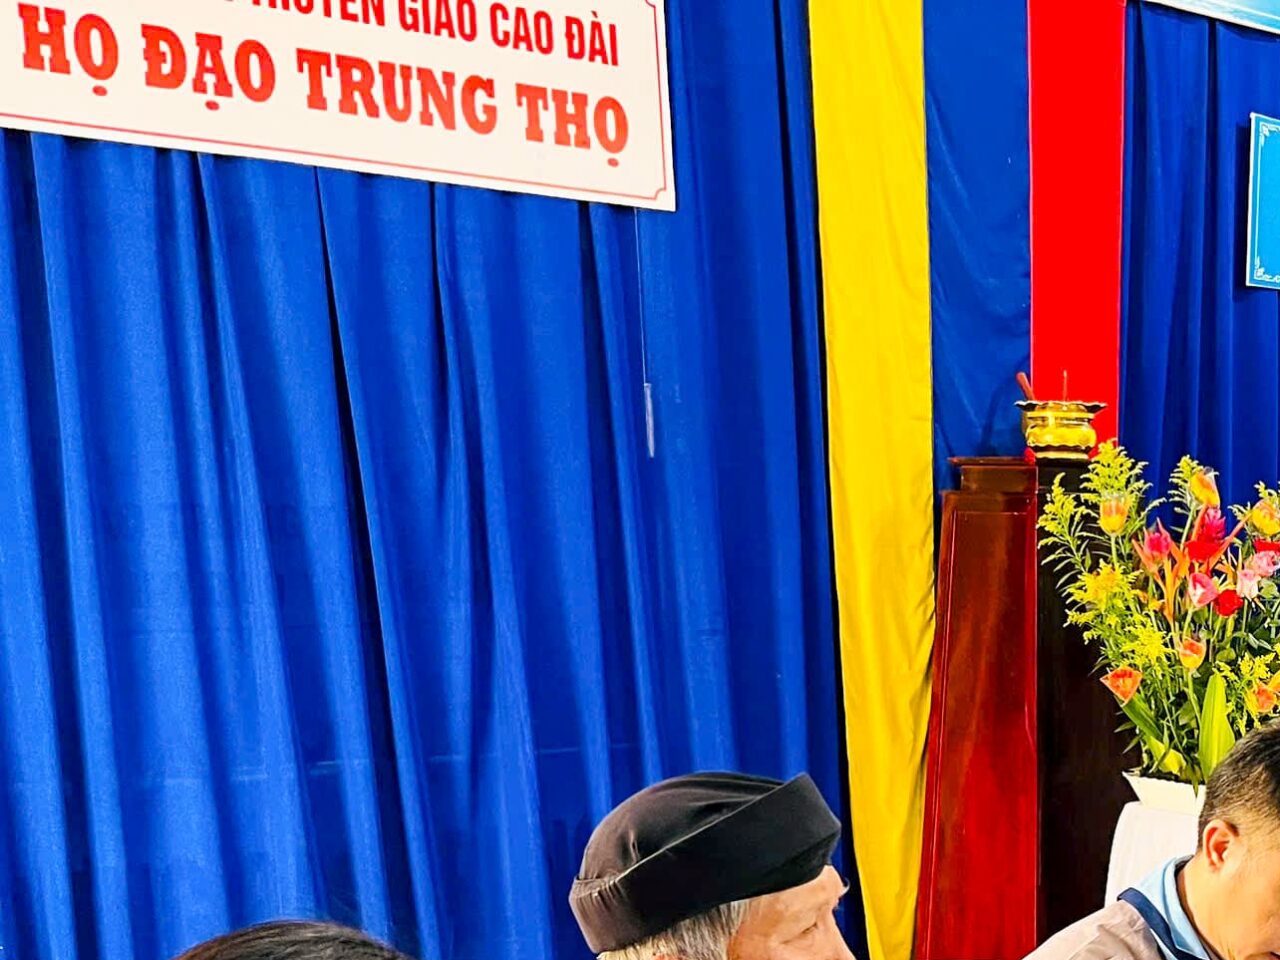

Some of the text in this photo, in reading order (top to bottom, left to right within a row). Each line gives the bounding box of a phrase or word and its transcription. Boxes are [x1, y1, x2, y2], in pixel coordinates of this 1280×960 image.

[17, 2, 629, 167] HỌ ĐẠO TRUNG THỌ
[489, 2, 554, 55] CAO
[564, 10, 619, 67] ĐÀI
